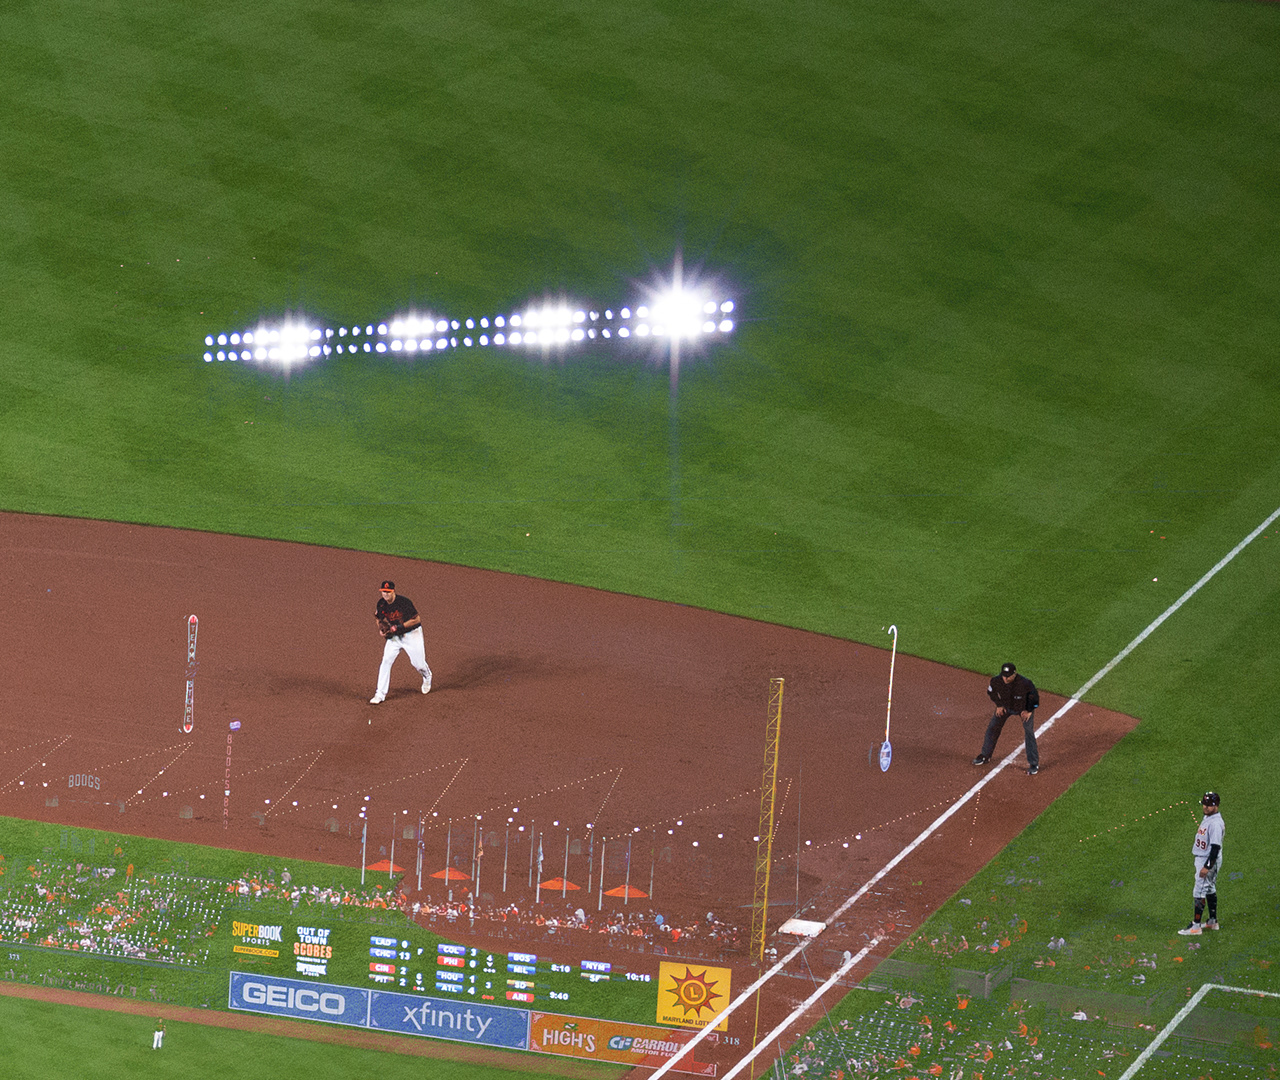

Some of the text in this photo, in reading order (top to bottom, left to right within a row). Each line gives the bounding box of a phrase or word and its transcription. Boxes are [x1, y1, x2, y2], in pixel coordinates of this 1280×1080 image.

[232, 920, 282, 942] SUPERBOOK
[297, 926, 330, 936] OUT OF
[242, 937, 270, 946] SPORTS
[299, 934, 327, 945] TOWN
[234, 946, 278, 956] SUPERBOOK.COM
[294, 942, 332, 959] SCORES
[443, 946, 460, 954] COL
[399, 952, 411, 960] 13
[444, 957, 458, 965] PHI
[375, 964, 389, 972] CIN
[400, 967, 407, 975] 2
[586, 963, 605, 971] NYM
[375, 975, 388, 983] PIT
[441, 972, 458, 980] HOU
[400, 978, 406, 986] 2
[441, 984, 457, 992] ATL
[468, 986, 475, 995] 4
[242, 982, 345, 1015] GEICO
[512, 993, 527, 1001] ARI
[550, 992, 569, 1000] 9:40
[403, 1002, 493, 1039] xfinity
[662, 1015, 693, 1025] MARYLAND
[542, 1029, 596, 1053] HIGH'S
[722, 1036, 740, 1046] 318
[631, 1048, 660, 1057] MOTOR
